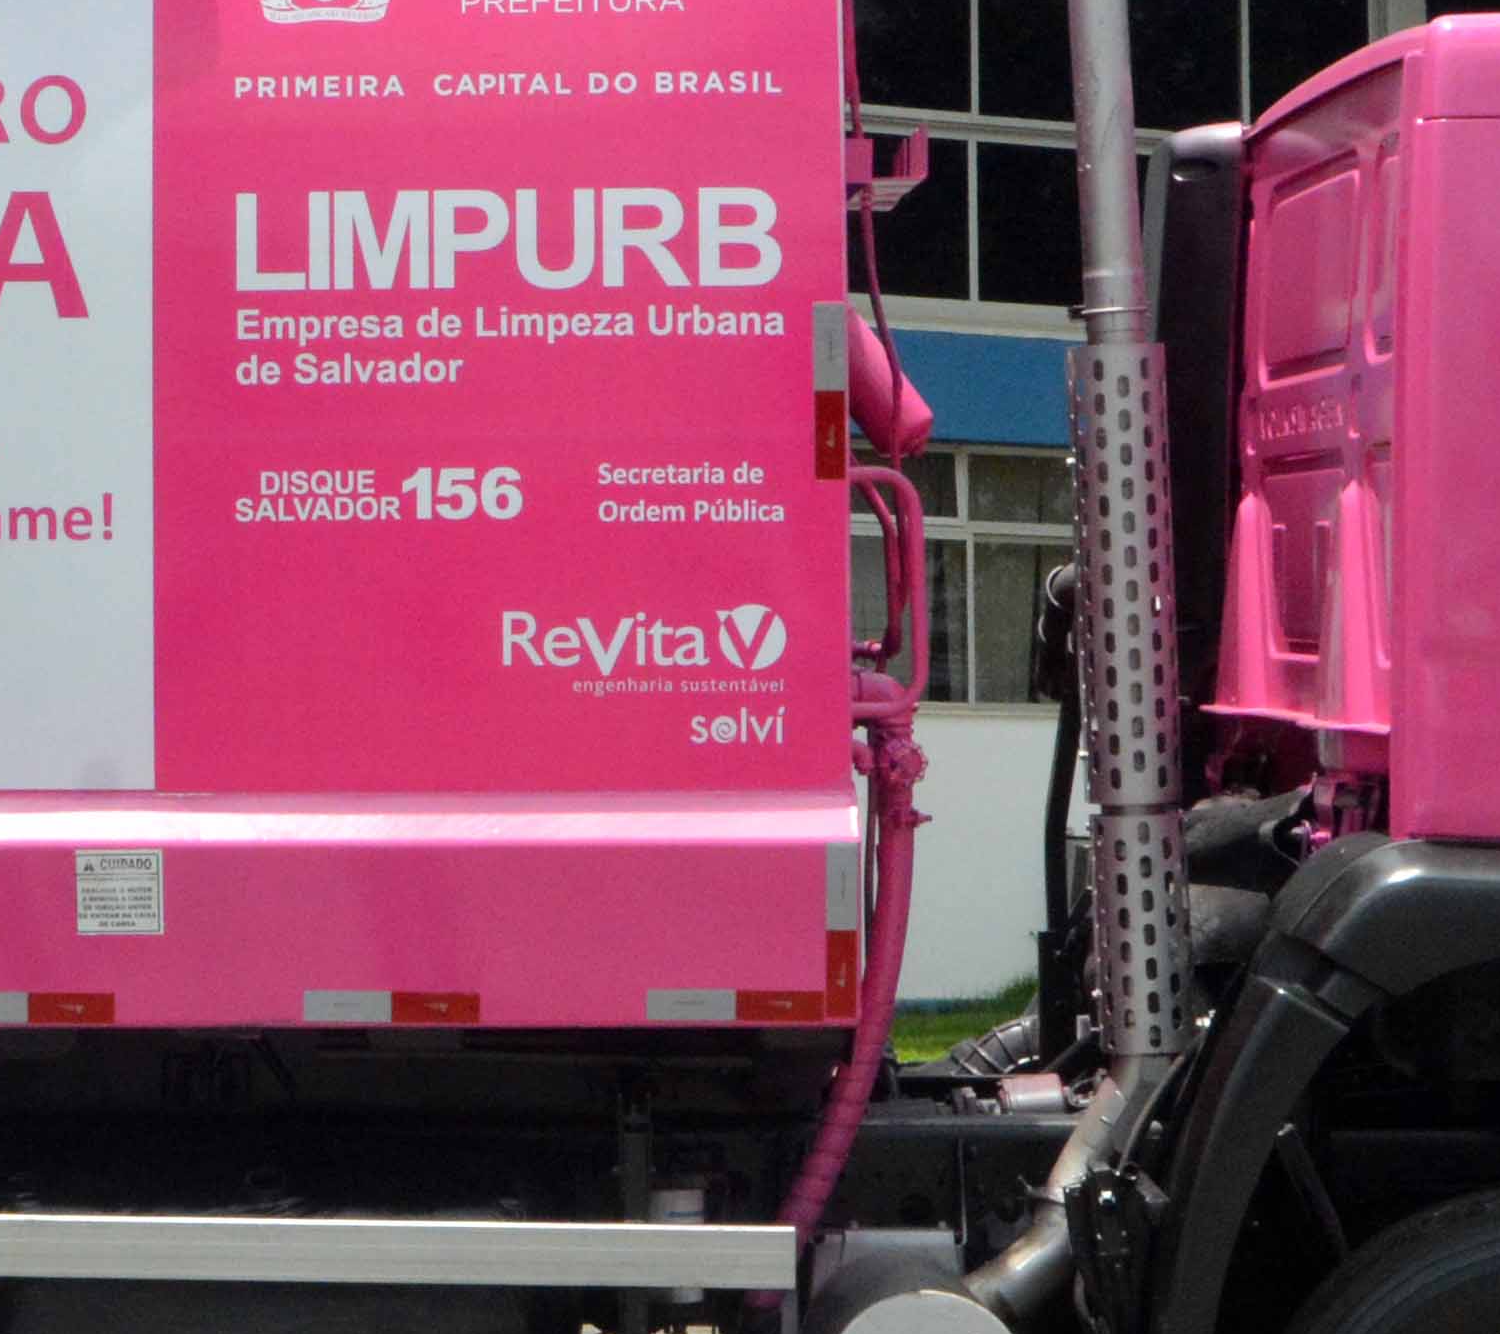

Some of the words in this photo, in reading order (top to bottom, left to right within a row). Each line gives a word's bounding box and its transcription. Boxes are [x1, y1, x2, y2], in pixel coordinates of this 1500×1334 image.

[234, 74, 406, 99] PRIMEIRA
[433, 71, 572, 96] CAPITAL
[588, 71, 638, 95] DO
[654, 70, 783, 95] BRASIL
[235, 185, 783, 292] LIMPURB
[236, 307, 404, 348] Empresa
[416, 306, 463, 338] de
[475, 305, 636, 346] Limpeza
[647, 304, 785, 337] Urbana
[235, 354, 281, 386] de
[293, 352, 464, 386] Salvador
[260, 469, 376, 496] DISQUE
[598, 461, 726, 485] Secretaria
[732, 461, 765, 485] de
[235, 497, 401, 523] SALVADOR
[402, 466, 524, 521] 156
[598, 499, 686, 523] Ordem
[694, 497, 786, 523] Pública
[502, 610, 710, 677] ReVita
[572, 677, 674, 696] engenharia
[680, 677, 785, 693] sustentável
[100, 858, 152, 870] CUIDADO
